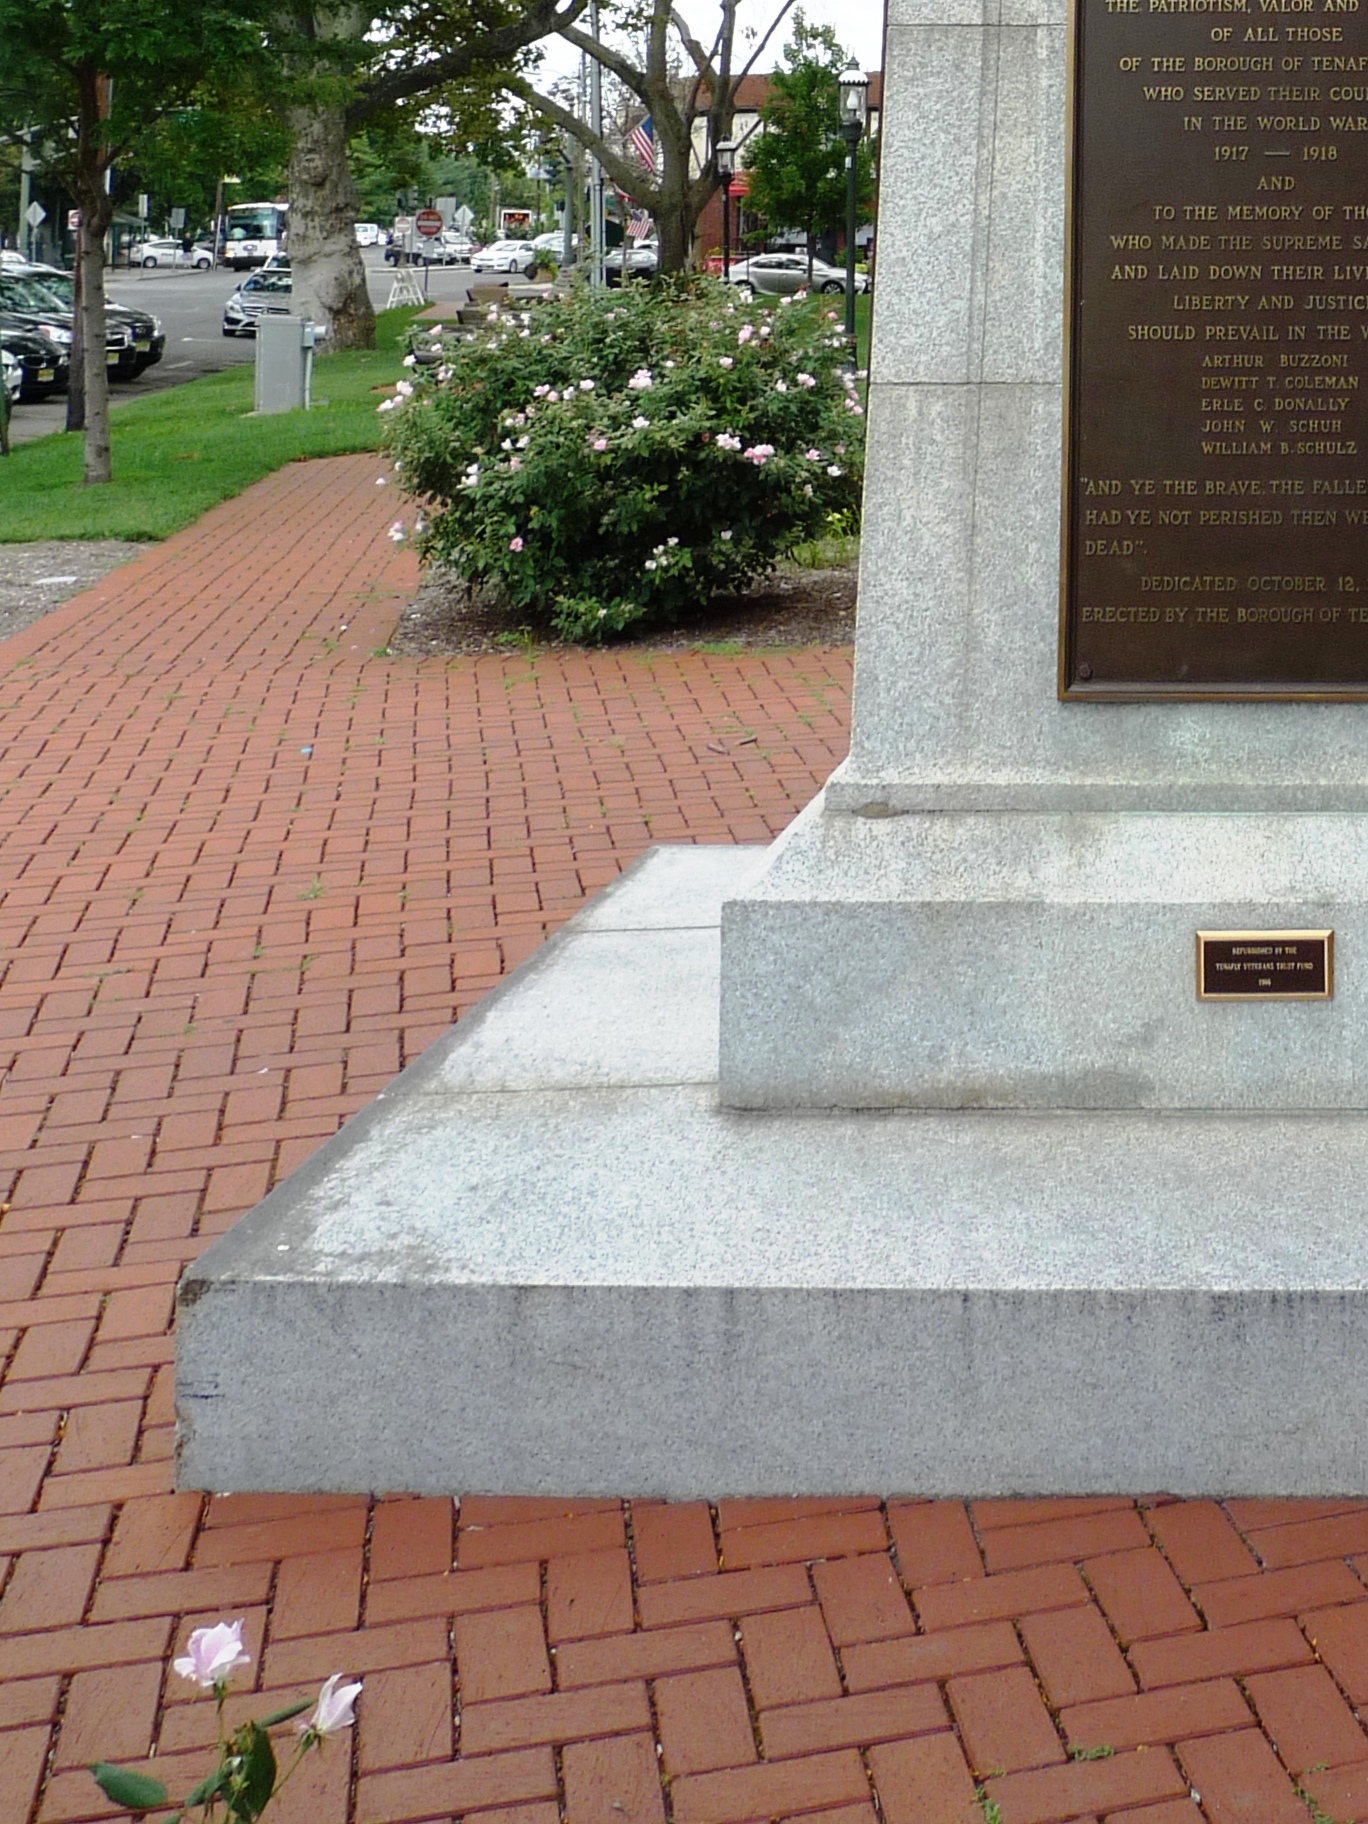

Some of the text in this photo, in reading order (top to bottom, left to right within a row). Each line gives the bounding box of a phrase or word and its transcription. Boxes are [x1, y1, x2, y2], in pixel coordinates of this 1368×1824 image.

[1210, 26, 1343, 42] OF ALL THOSE
[1119, 56, 1143, 72] OF
[1150, 57, 1186, 72] THE
[1193, 56, 1274, 72] BOROUGH
[1281, 56, 1304, 71] OF
[1142, 86, 1184, 101] WHO
[1193, 86, 1261, 101] SERVED
[1267, 86, 1321, 101] THEIR
[1183, 115, 1368, 131] IN THE WORLD WAR
[1214, 145, 1249, 161] 1917
[1302, 145, 1338, 161] 1918
[1256, 175, 1295, 191] AND
[1152, 205, 1175, 220] TO
[1182, 205, 1218, 221] THE
[1227, 205, 1303, 221] MEMORY
[1312, 205, 1334, 220] OF
[1109, 234, 1152, 250] WHO
[1161, 234, 1211, 250] MADE
[1217, 235, 1252, 250] THE
[1262, 235, 1343, 250] SUPREME
[1110, 264, 1148, 280] AND
[1157, 264, 1200, 280] LAID
[1209, 265, 1262, 280] DOWN
[1270, 265, 1324, 280] THEIR
[1173, 294, 1250, 310] LIBERTY
[1257, 294, 1294, 310] AND
[1127, 324, 1196, 340] SHOULD
[1205, 325, 1279, 341] PREVAIL
[1287, 325, 1306, 340] IN
[1316, 324, 1351, 340] THE
[1201, 353, 1348, 368] ARTHUR BUZZONI
[1201, 376, 1260, 390] DEWITT
[1284, 375, 1359, 390] COLEMAN
[1200, 398, 1244, 412] ERLE
[1274, 397, 1350, 412] DONALLY
[1200, 419, 1246, 433] JOHN
[1289, 419, 1342, 433] SCHUH
[1200, 441, 1358, 455] WILLIAM B. SCHULZ
[1129, 478, 1156, 496] YE
[1162, 479, 1198, 496] THE
[1268, 479, 1305, 495] THE
[1084, 509, 1122, 526] HAD
[1124, 509, 1152, 526] YE
[1158, 509, 1193, 526] NOT
[1198, 509, 1283, 525] PERISHED
[1290, 509, 1337, 526] THEN
[1140, 575, 1239, 592] DEDICATED
[1247, 575, 1327, 592] OCTOBER
[1081, 606, 1161, 623] ERECTED
[1164, 606, 1191, 623] BY
[1194, 606, 1230, 623] THE
[1236, 607, 1315, 623] BOROUGH
[1319, 607, 1342, 623] OF
[1243, 962, 1274, 971] VETERANS
[1297, 962, 1313, 970] FUND
